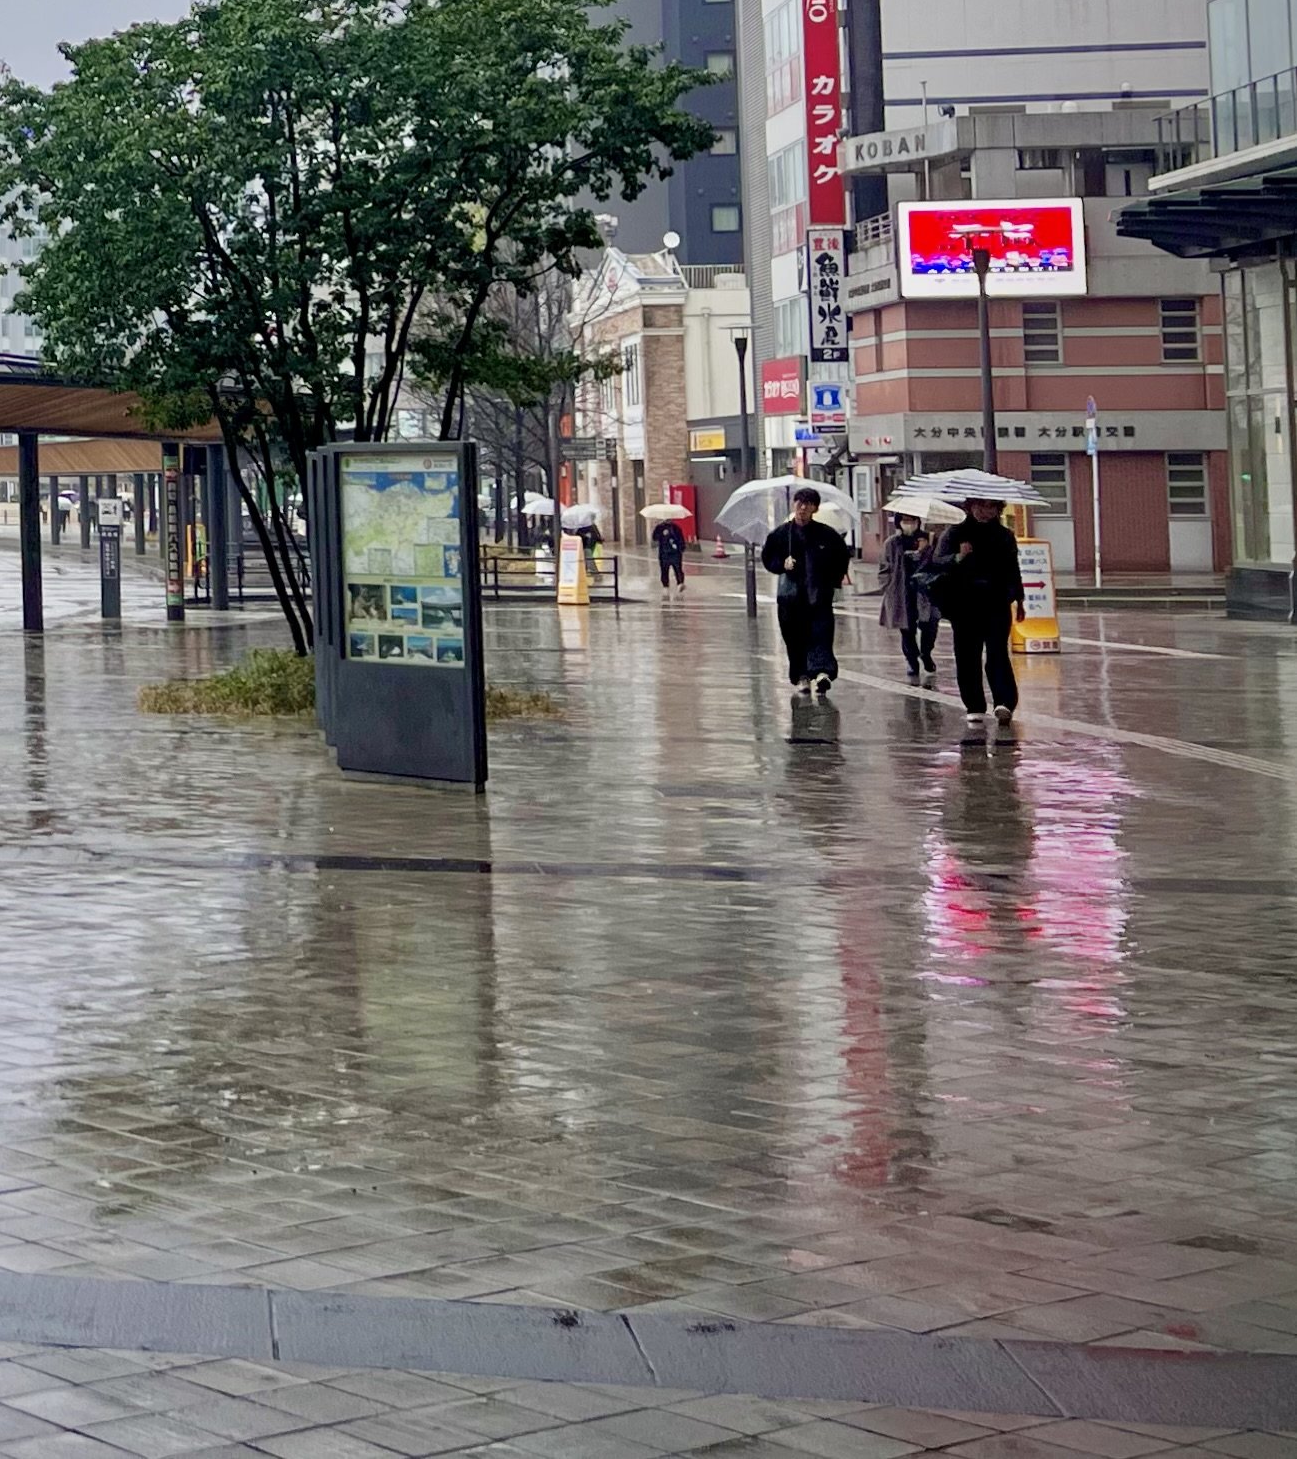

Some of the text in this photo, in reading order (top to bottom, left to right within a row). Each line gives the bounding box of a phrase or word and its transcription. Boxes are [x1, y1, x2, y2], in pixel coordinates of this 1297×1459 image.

[811, 75, 843, 184] カラオケ
[855, 133, 927, 162] KOBAN
[813, 237, 840, 251] 豊後
[822, 349, 841, 360] 2F
